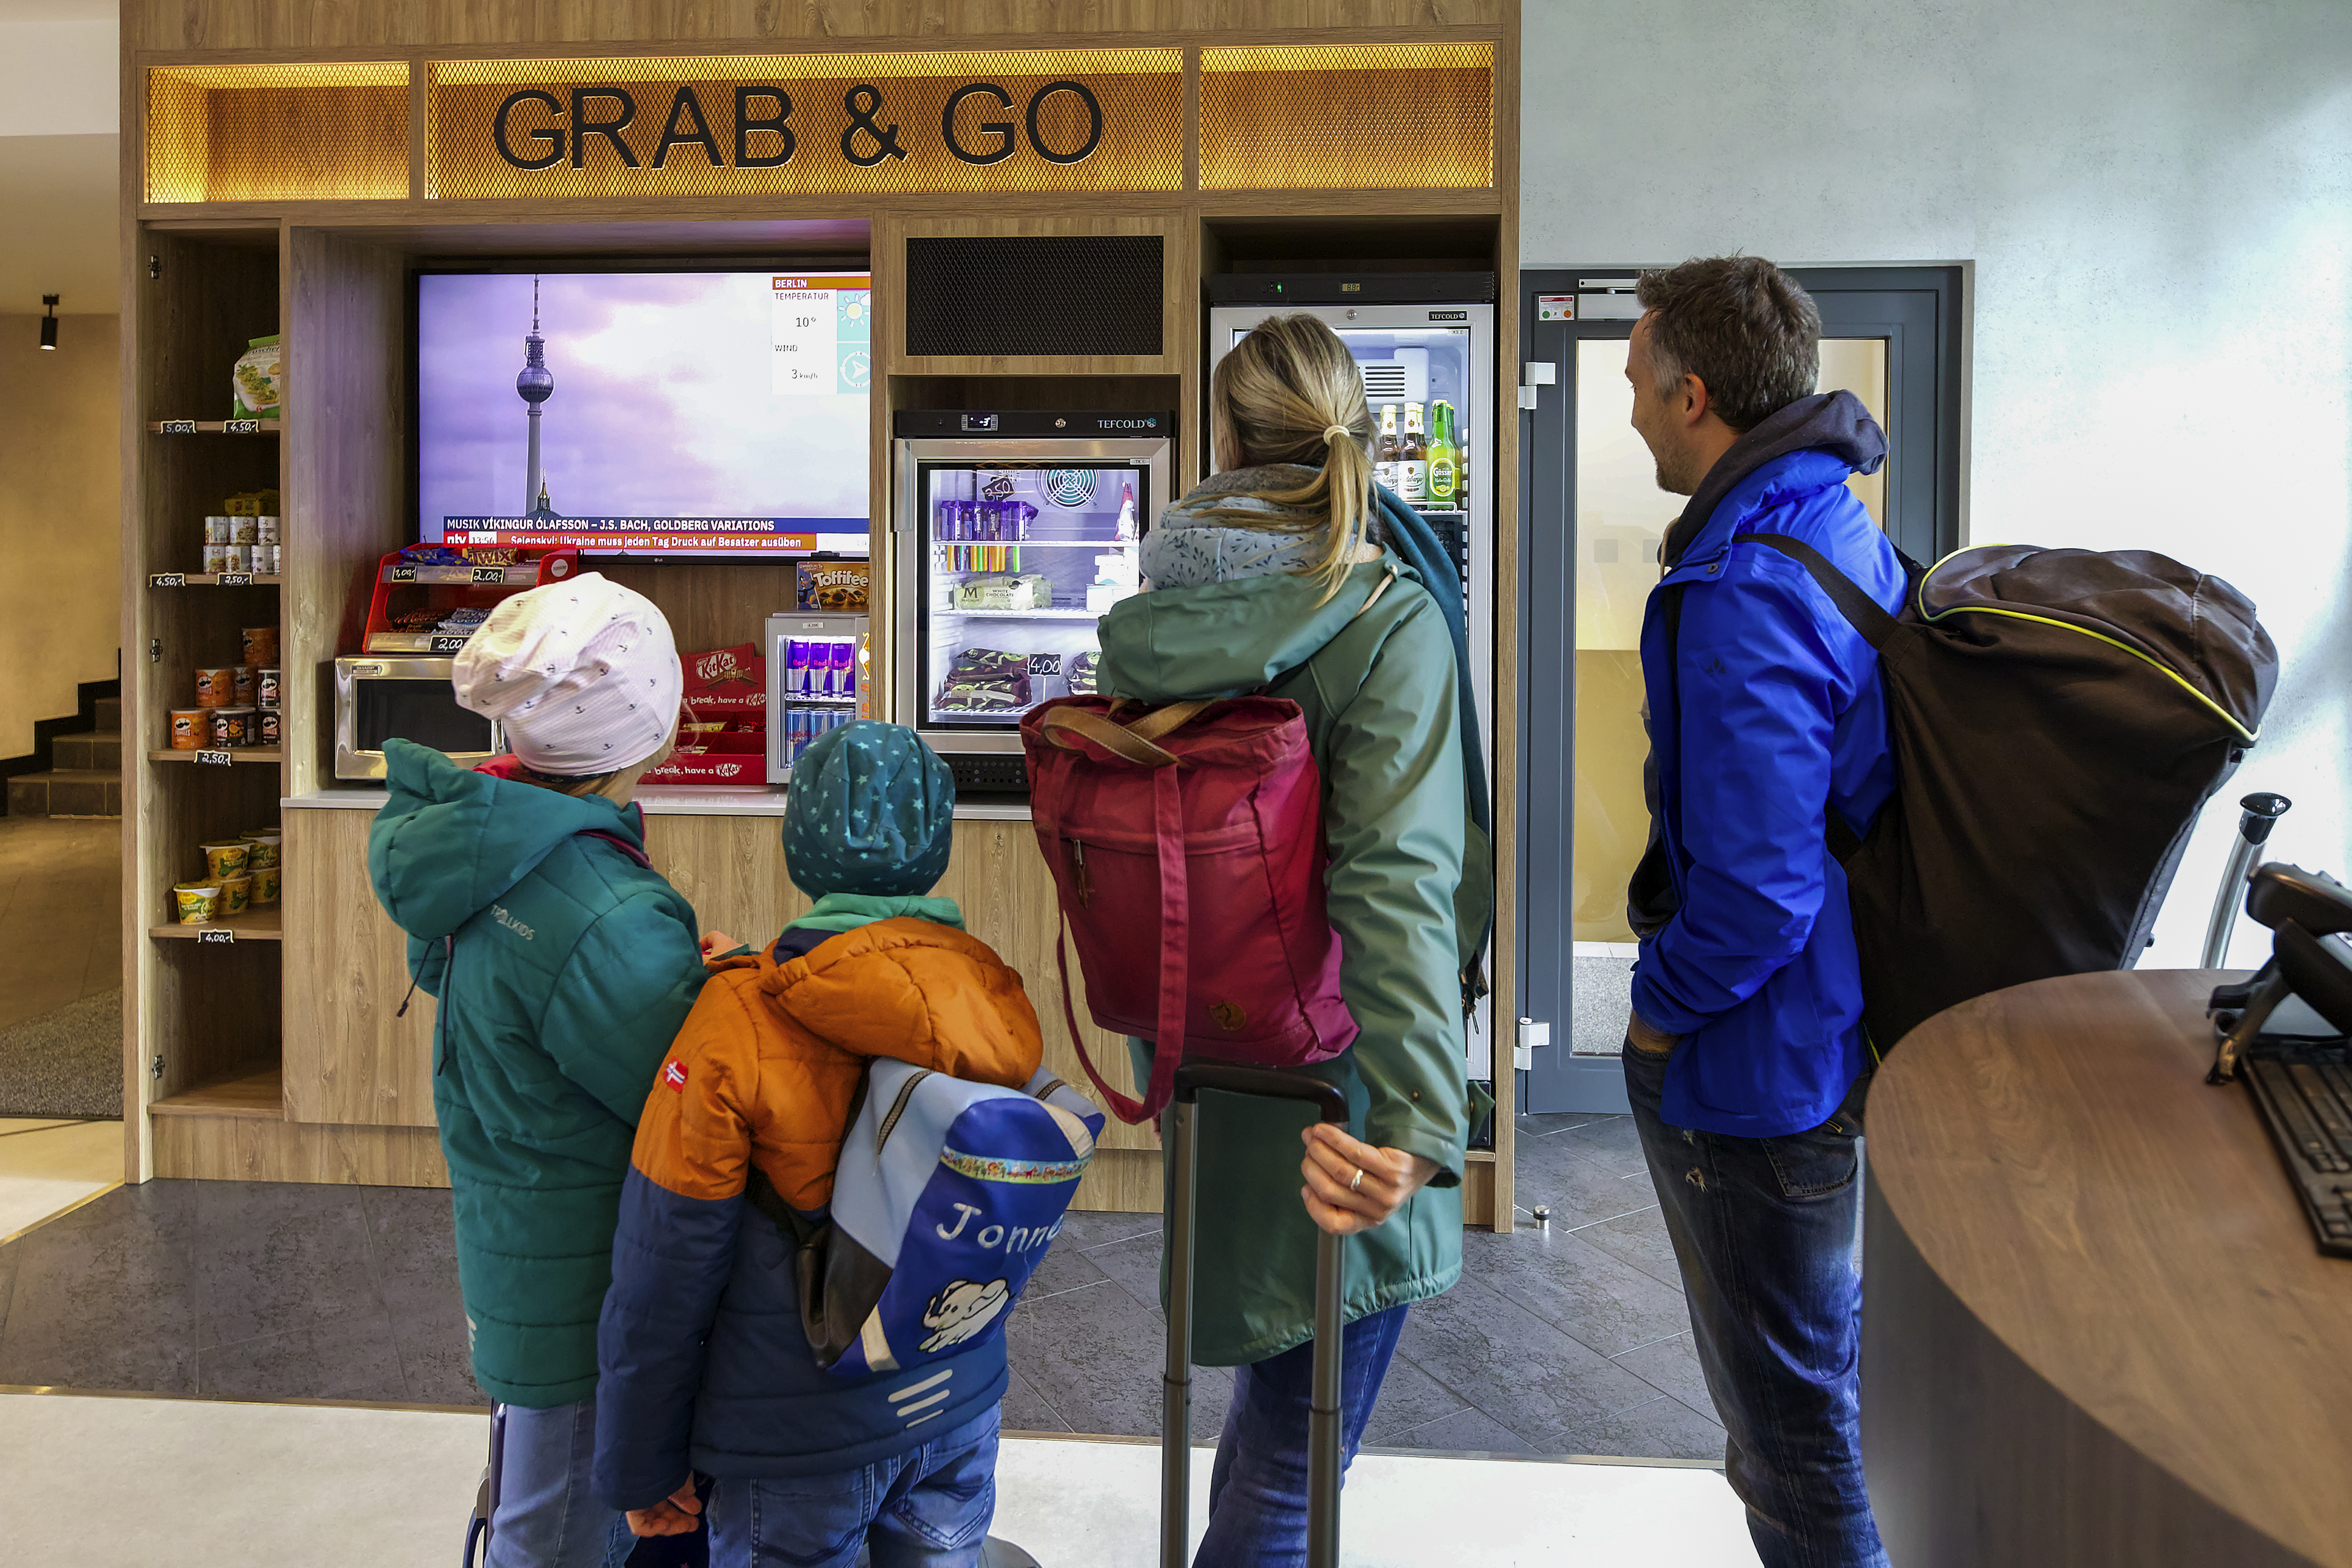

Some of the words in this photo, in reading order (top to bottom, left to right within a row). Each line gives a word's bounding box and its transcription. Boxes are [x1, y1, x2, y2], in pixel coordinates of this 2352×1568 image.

[493, 85, 795, 170] GRAB
[840, 83, 908, 168] &
[941, 80, 1104, 165] GO
[774, 278, 807, 288] BERLIN
[796, 317, 816, 327] 10°
[791, 369, 798, 379] 3
[1097, 419, 1145, 428] TEFCOLD
[447, 519, 480, 529] MUSIK
[482, 515, 533, 529] VÍKINGUR
[536, 516, 589, 530] ÓLAFSSON
[599, 519, 618, 530] J.S.
[620, 519, 651, 532] BACH,
[653, 520, 709, 531] GOLDBERG
[711, 520, 775, 531] VARIATIONS
[559, 535, 595, 546] Ukraine
[598, 538, 622, 546] muss
[624, 535, 650, 548] jeden
[652, 536, 669, 549] Tag
[671, 536, 699, 547] Druck
[701, 536, 716, 547] auf
[718, 536, 760, 547] Besatzer
[761, 536, 801, 547] ausüben
[468, 549, 512, 566] TWIX
[813, 570, 869, 587] Toffifee
[963, 587, 978, 598] M
[701, 653, 734, 678] KitKat
[1030, 657, 1060, 674] 4,00
[690, 695, 716, 705] break,
[654, 765, 683, 775] break,
[685, 766, 706, 774] have
[718, 763, 739, 776] KitKat
